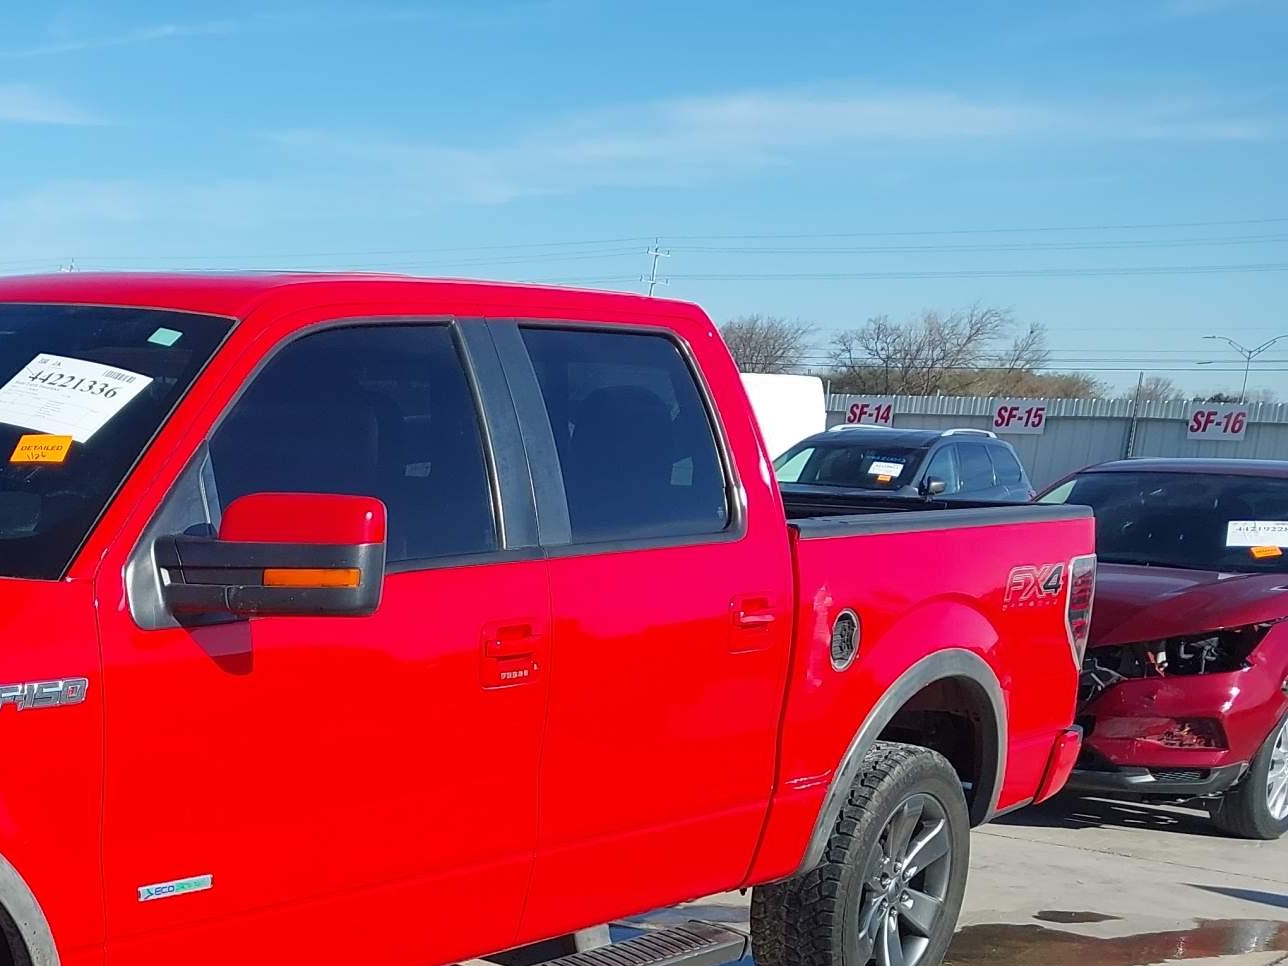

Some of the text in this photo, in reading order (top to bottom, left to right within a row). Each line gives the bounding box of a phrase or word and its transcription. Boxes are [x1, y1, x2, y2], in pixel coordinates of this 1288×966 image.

[28, 369, 121, 398] 44221336
[847, 403, 893, 424] SF-14
[994, 405, 1046, 428] SF-15
[1189, 410, 1247, 434] SF-16
[1003, 563, 1065, 602] FX4
